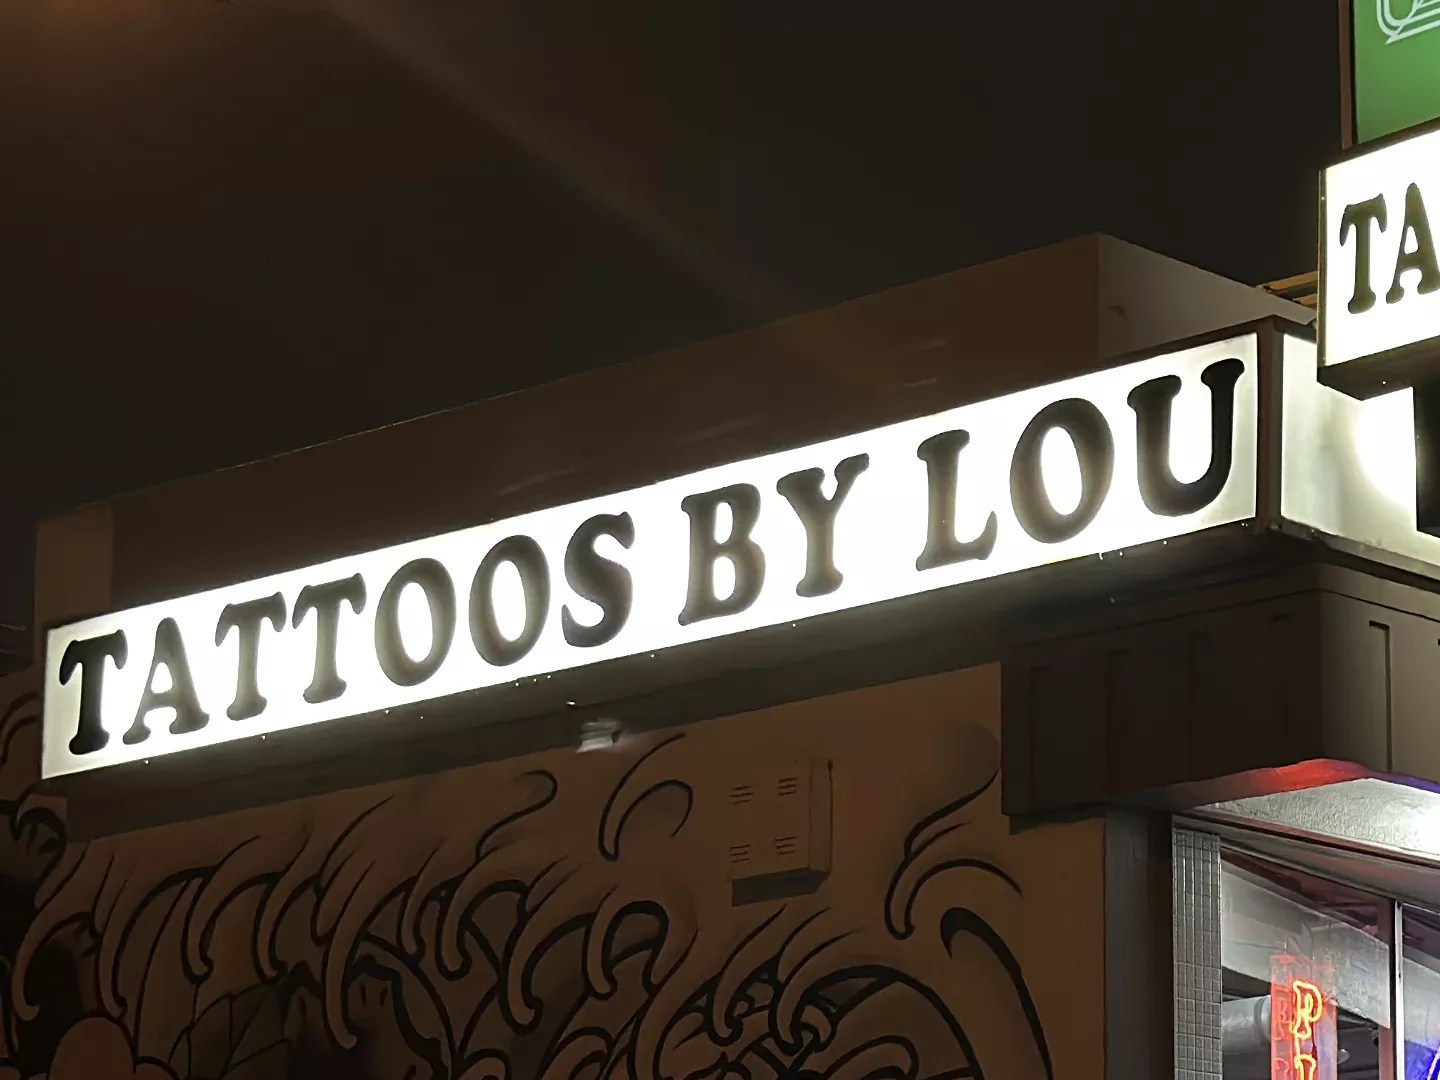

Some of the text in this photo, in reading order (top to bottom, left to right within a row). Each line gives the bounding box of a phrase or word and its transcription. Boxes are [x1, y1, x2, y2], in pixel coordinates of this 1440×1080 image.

[59, 357, 1246, 756] TATTOOS BY LOU
